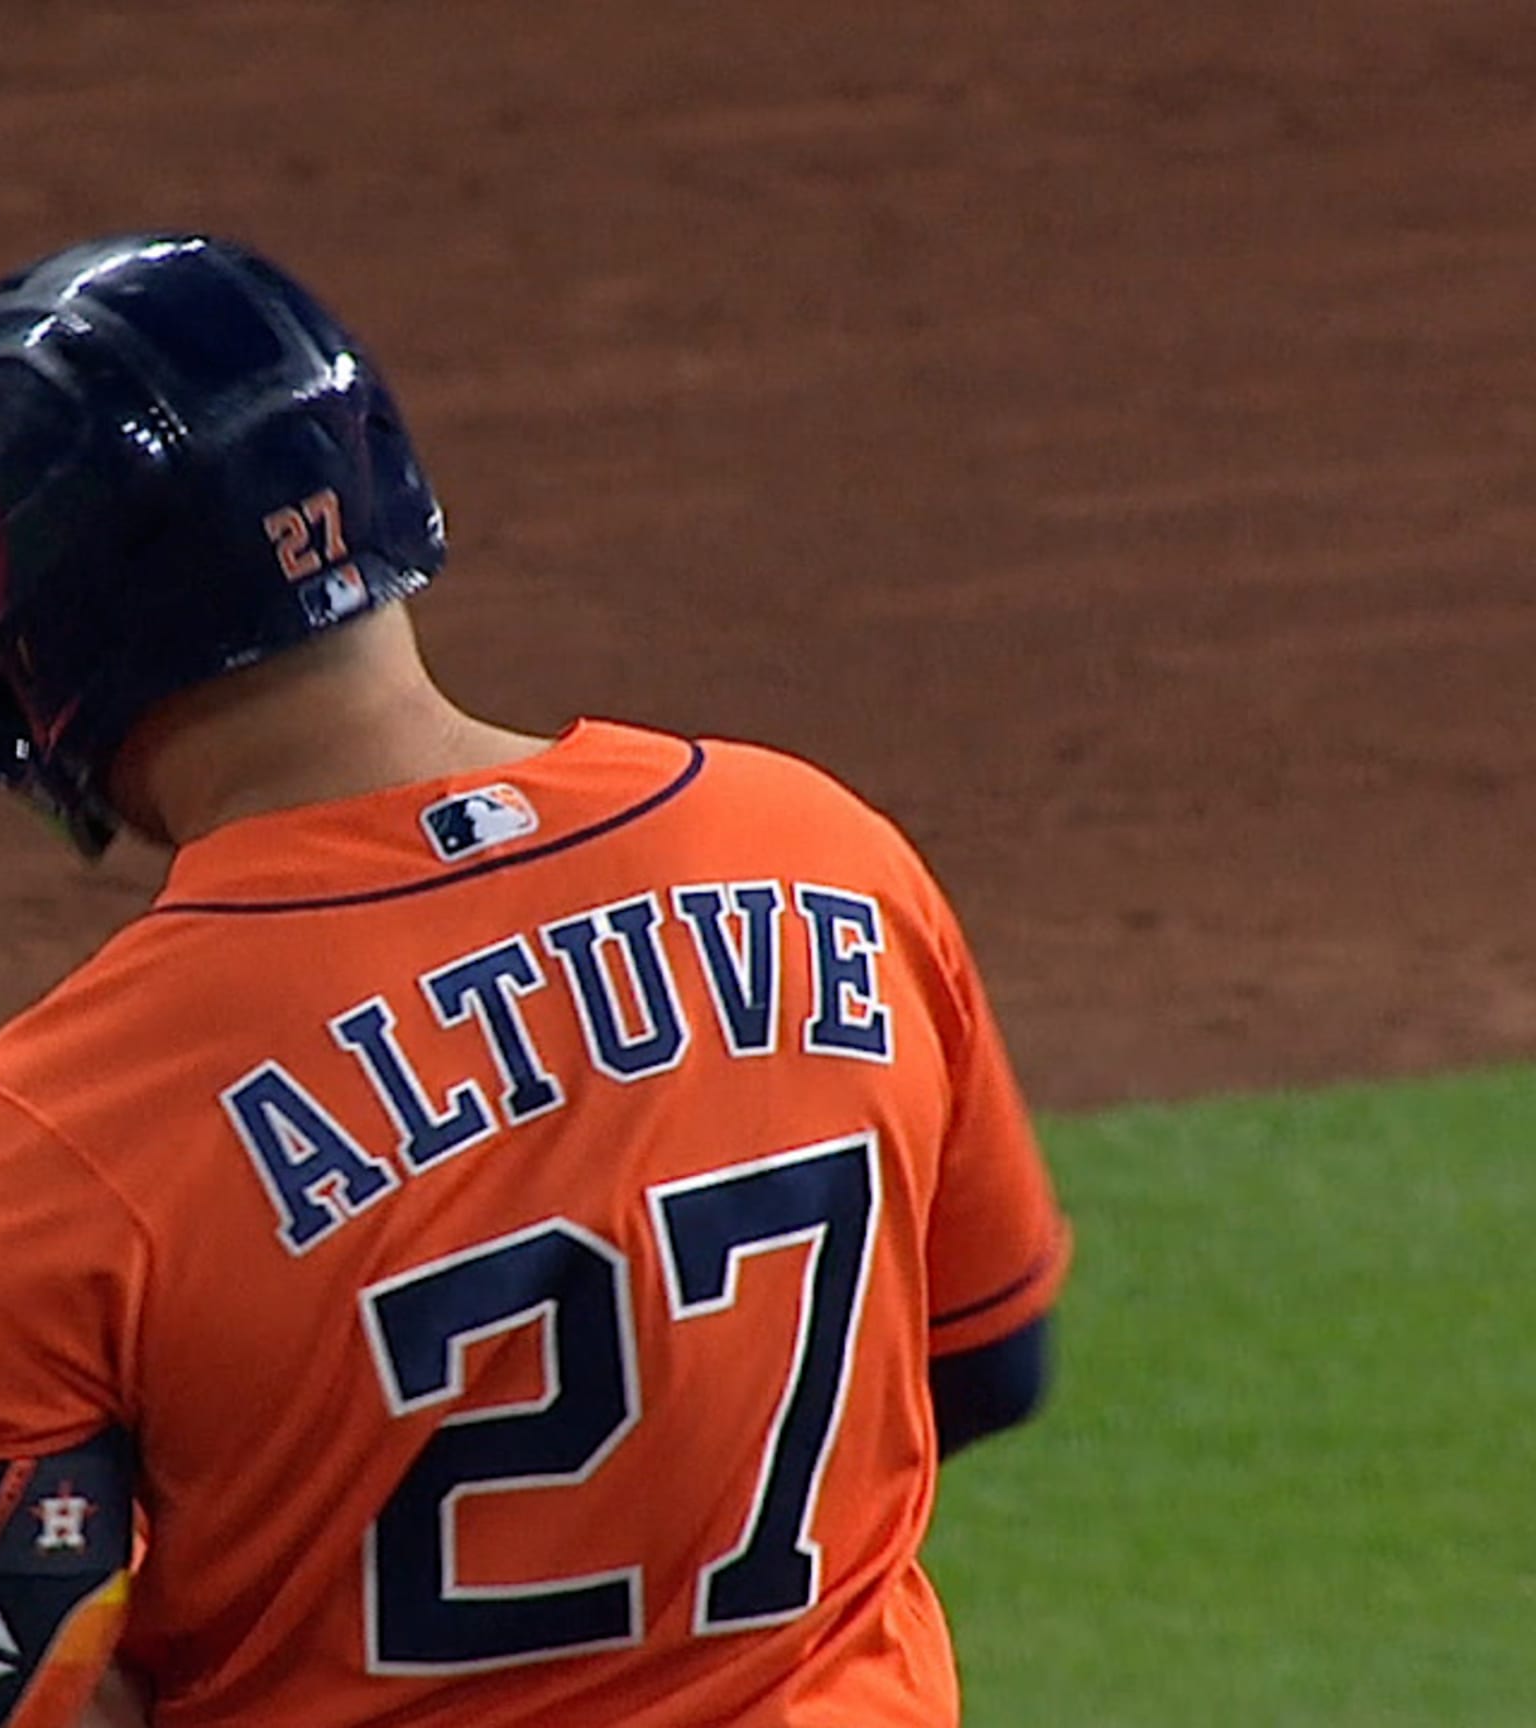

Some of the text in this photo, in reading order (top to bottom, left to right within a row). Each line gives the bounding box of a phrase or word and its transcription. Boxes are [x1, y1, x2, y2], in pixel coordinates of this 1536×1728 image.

[265, 489, 347, 582] 27
[221, 880, 894, 1255] ALTUVE
[359, 1130, 883, 1673] 27
